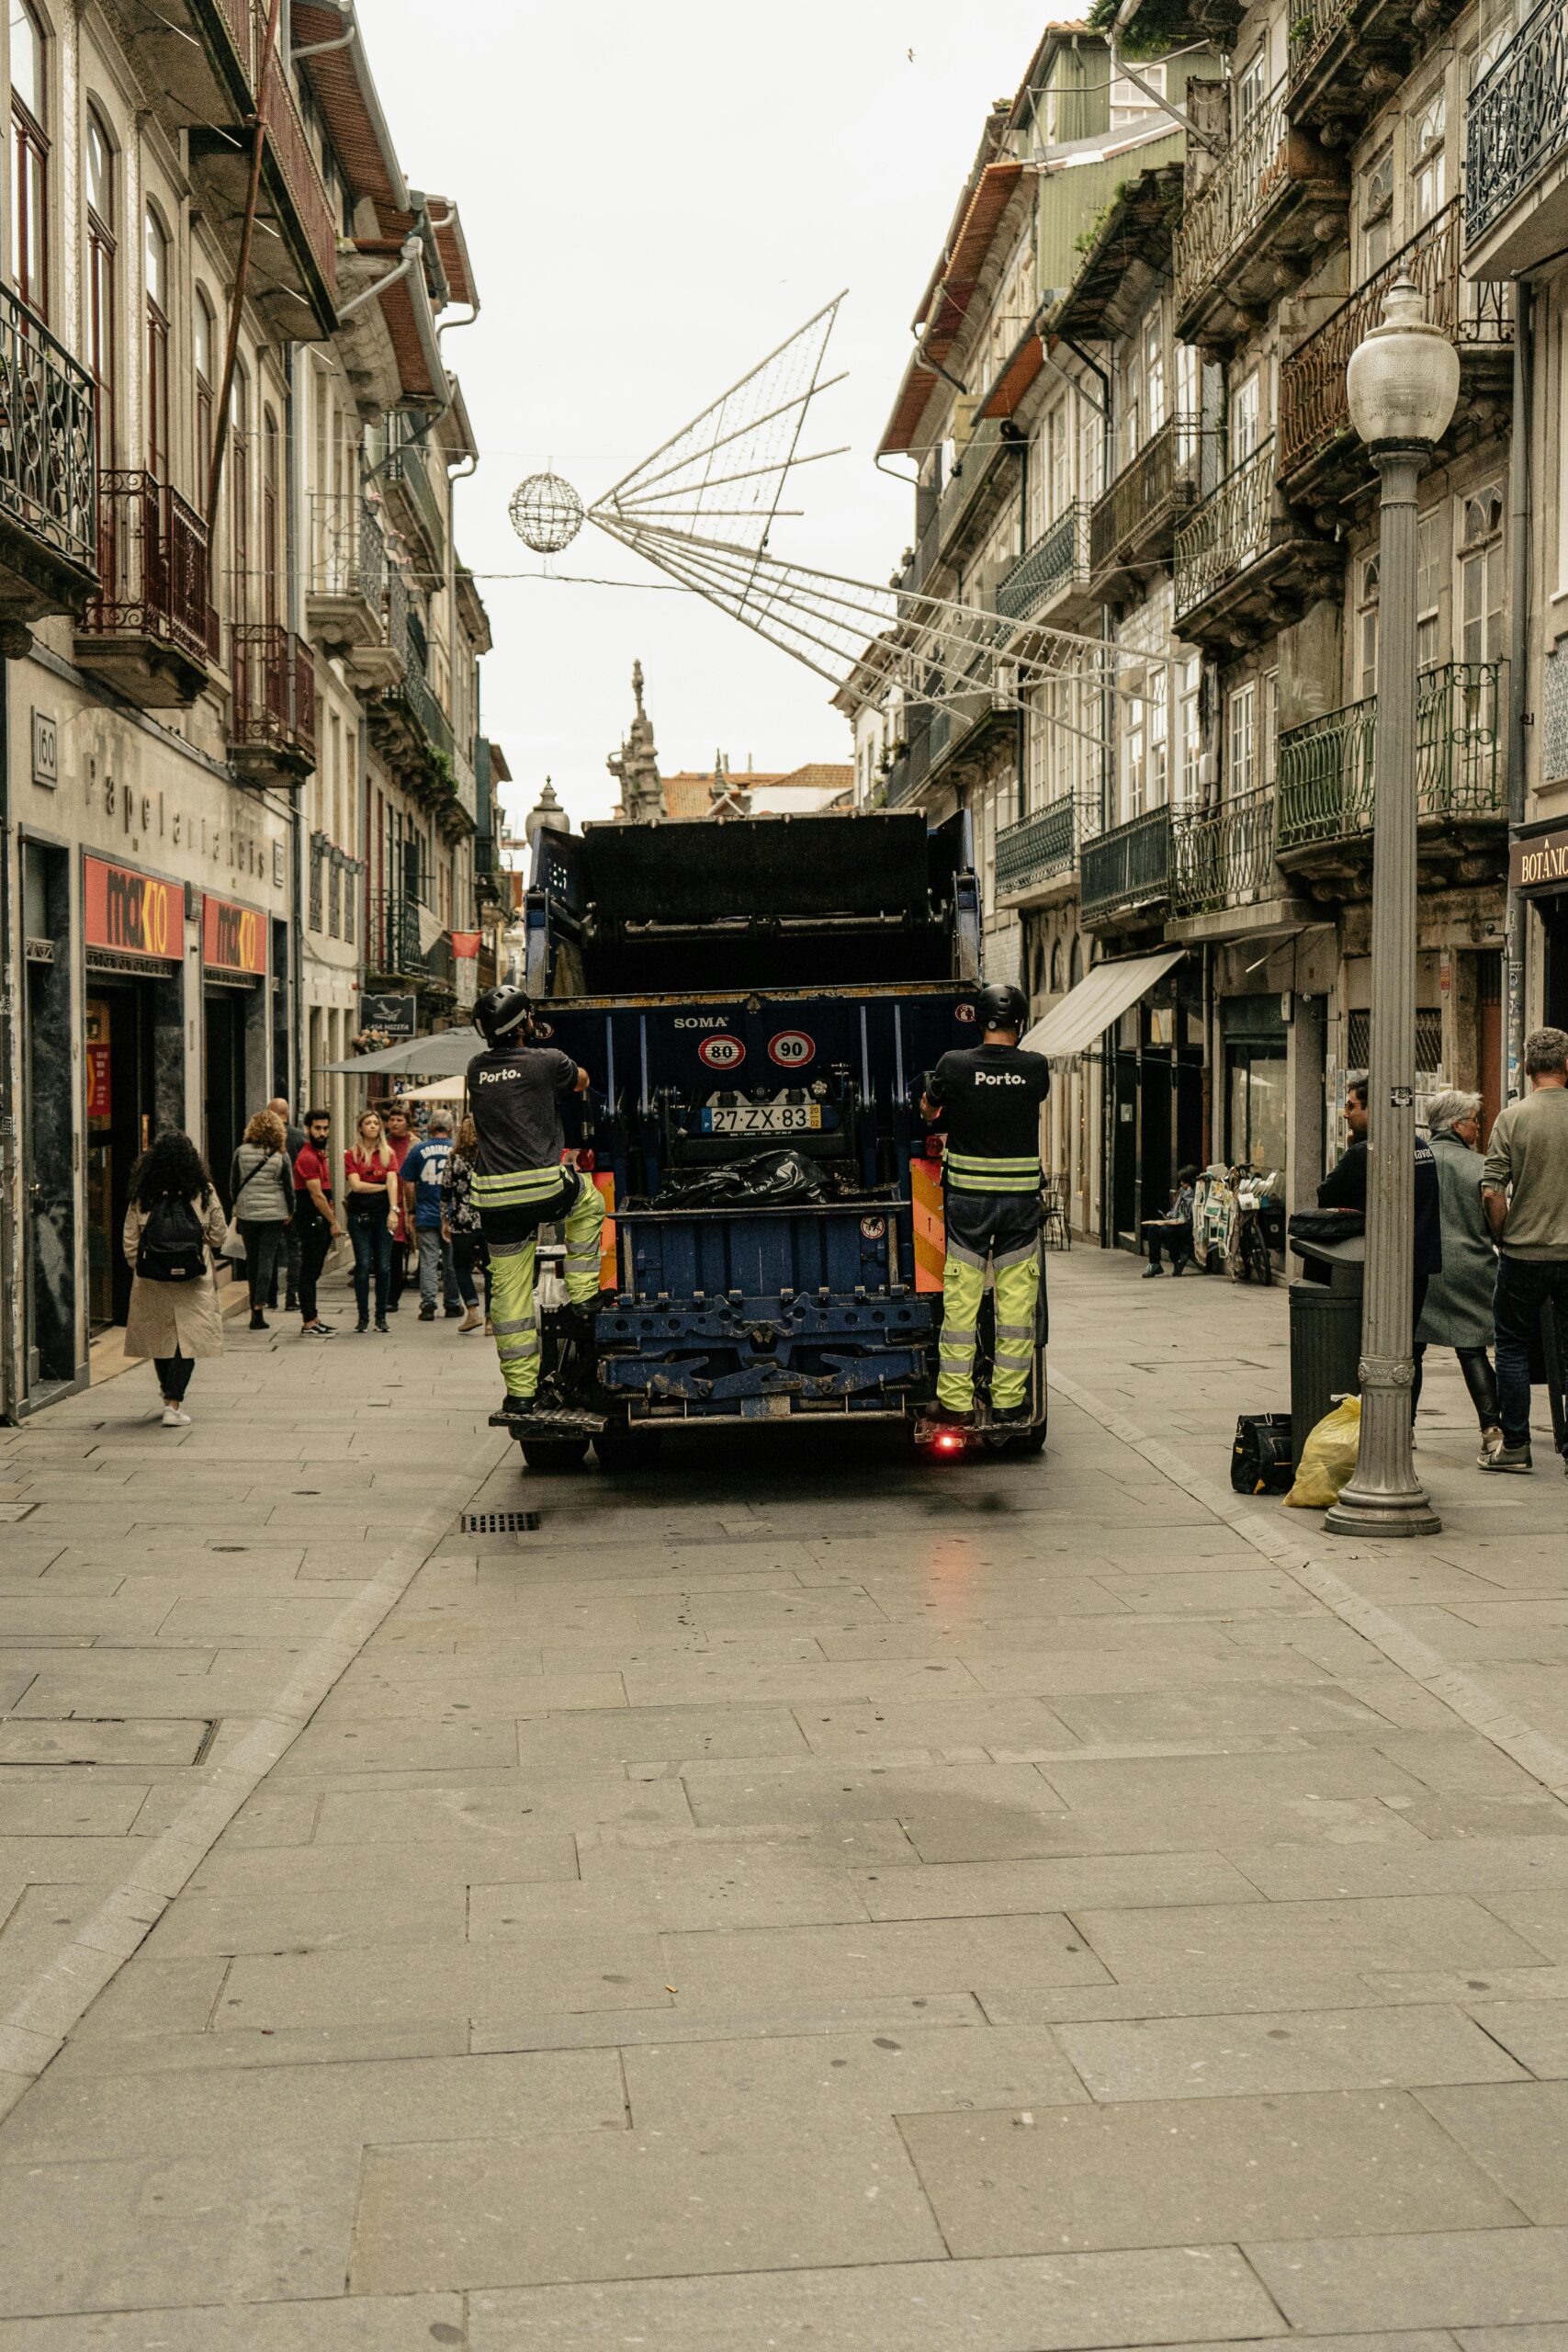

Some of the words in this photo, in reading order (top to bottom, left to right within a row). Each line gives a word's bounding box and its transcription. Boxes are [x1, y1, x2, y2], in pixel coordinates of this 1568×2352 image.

[39, 728, 54, 768] 160
[711, 1046, 733, 1058] 80
[781, 1042, 803, 1057] 90
[479, 1069, 522, 1084] Porto.
[975, 1071, 1026, 1085] Porto.
